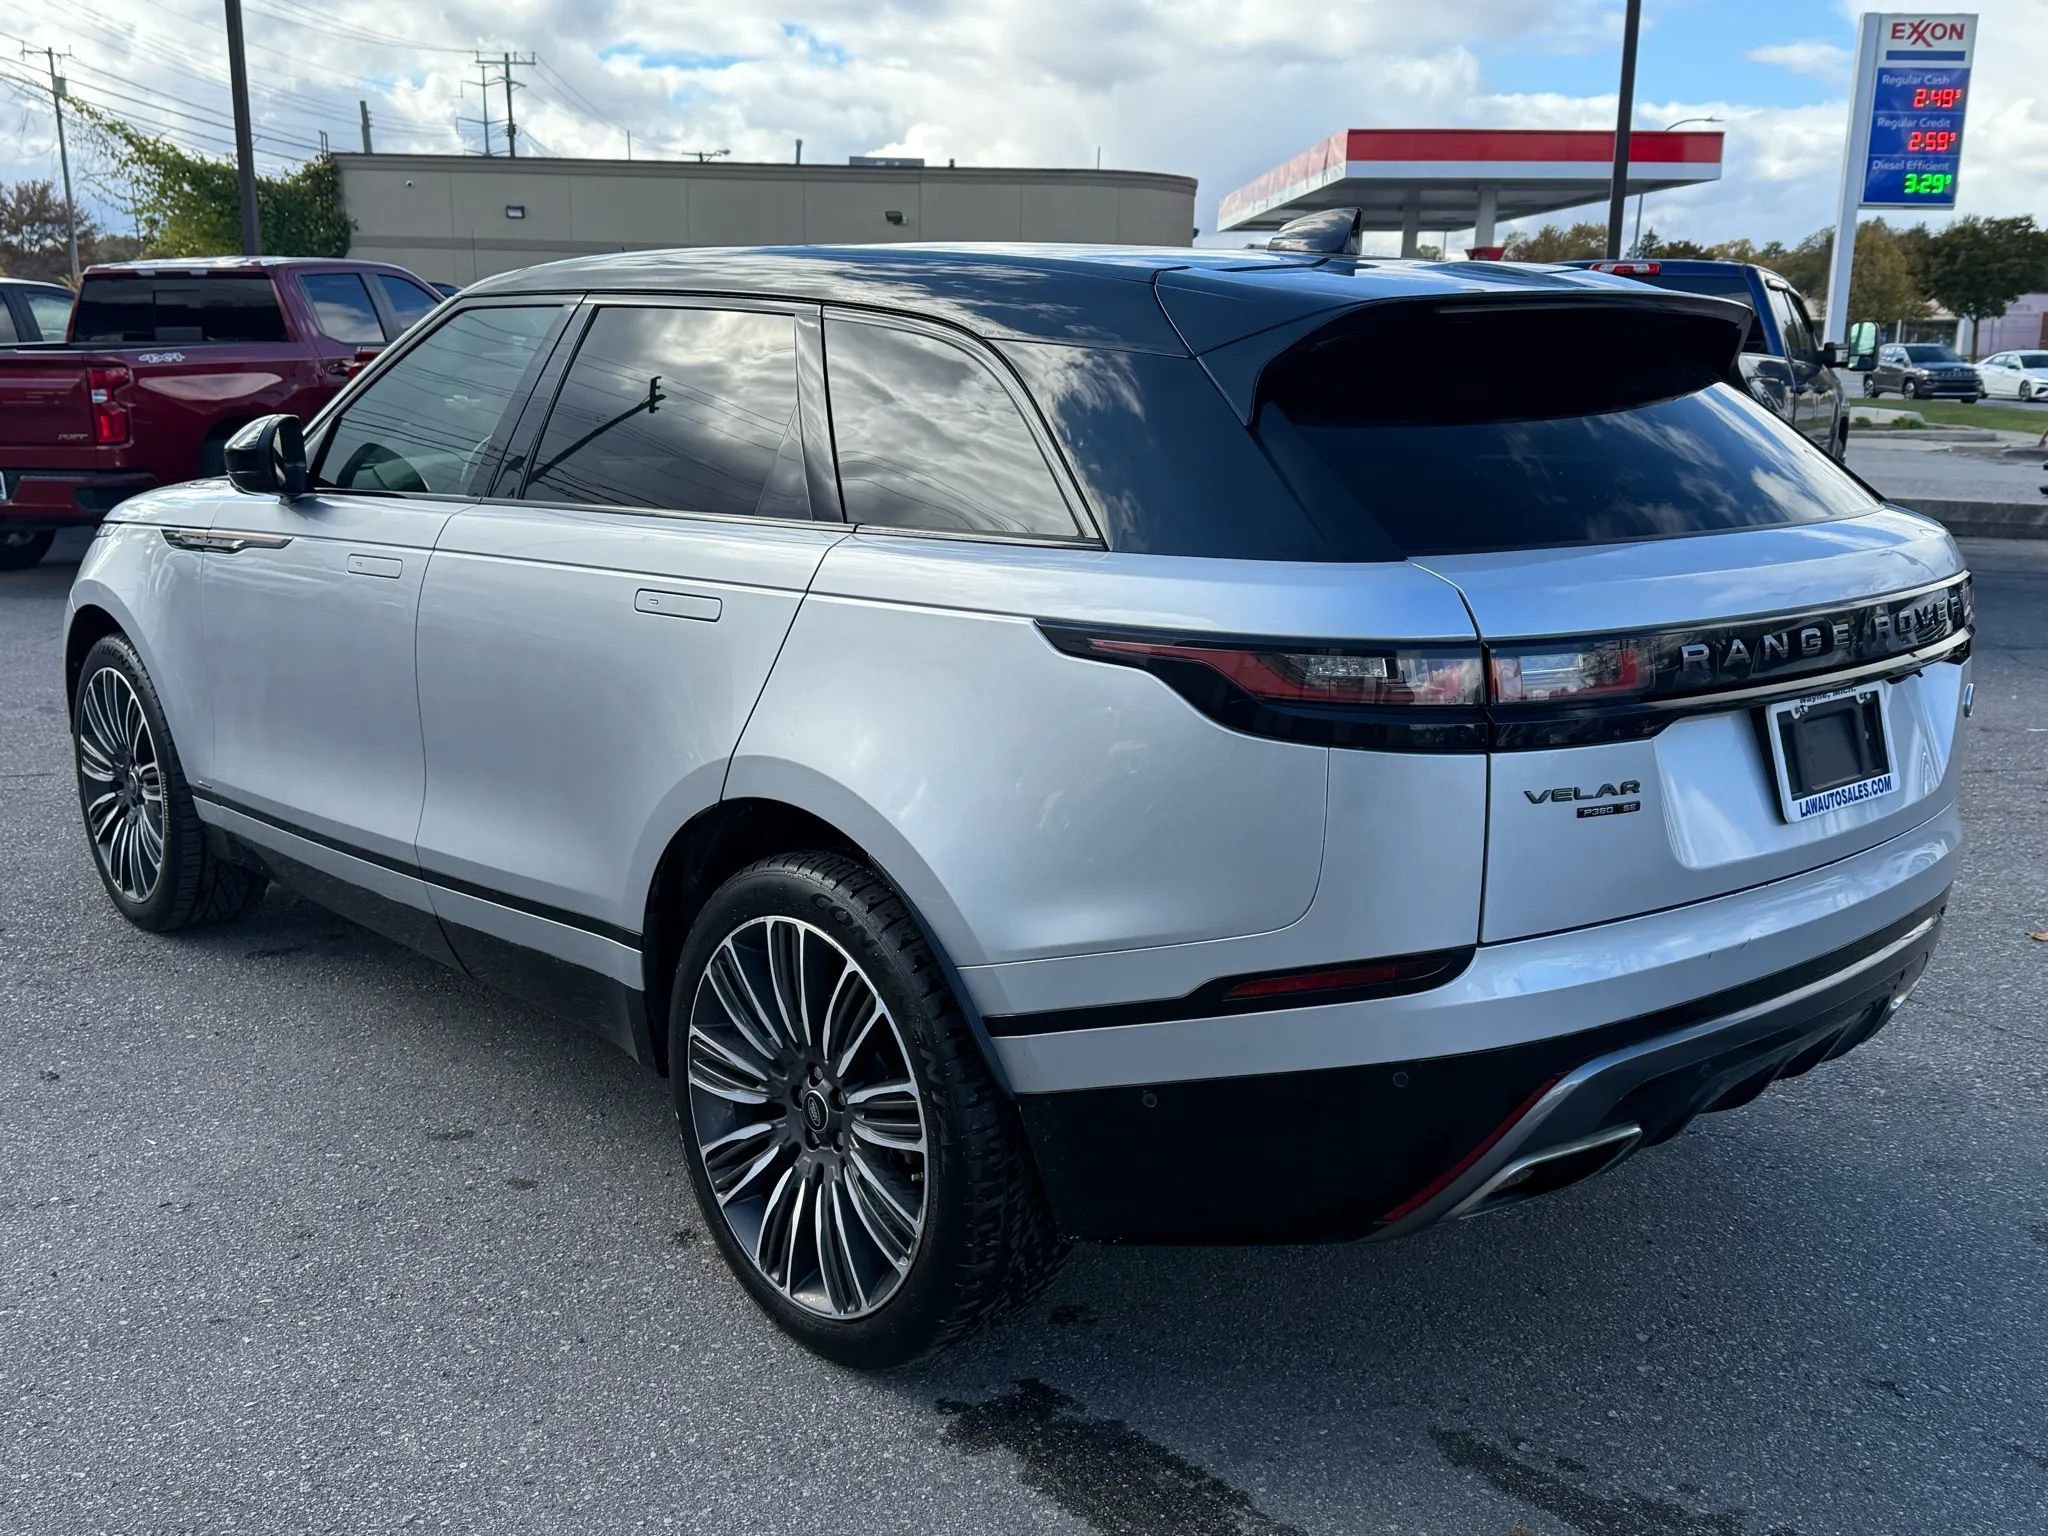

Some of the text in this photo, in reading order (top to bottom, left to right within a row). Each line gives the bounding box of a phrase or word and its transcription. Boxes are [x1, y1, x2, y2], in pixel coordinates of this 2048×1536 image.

[1891, 19, 1965, 47] EXXON
[1882, 74, 1950, 88] Regular Cash
[1877, 117, 1951, 130] Regular Credit
[1872, 160, 1949, 172] Diesel Efficient
[1681, 623, 1850, 671] RANGE
[1523, 779, 1641, 804] VELAR
[1799, 775, 1893, 818] LAWAUTOSALES.COM
